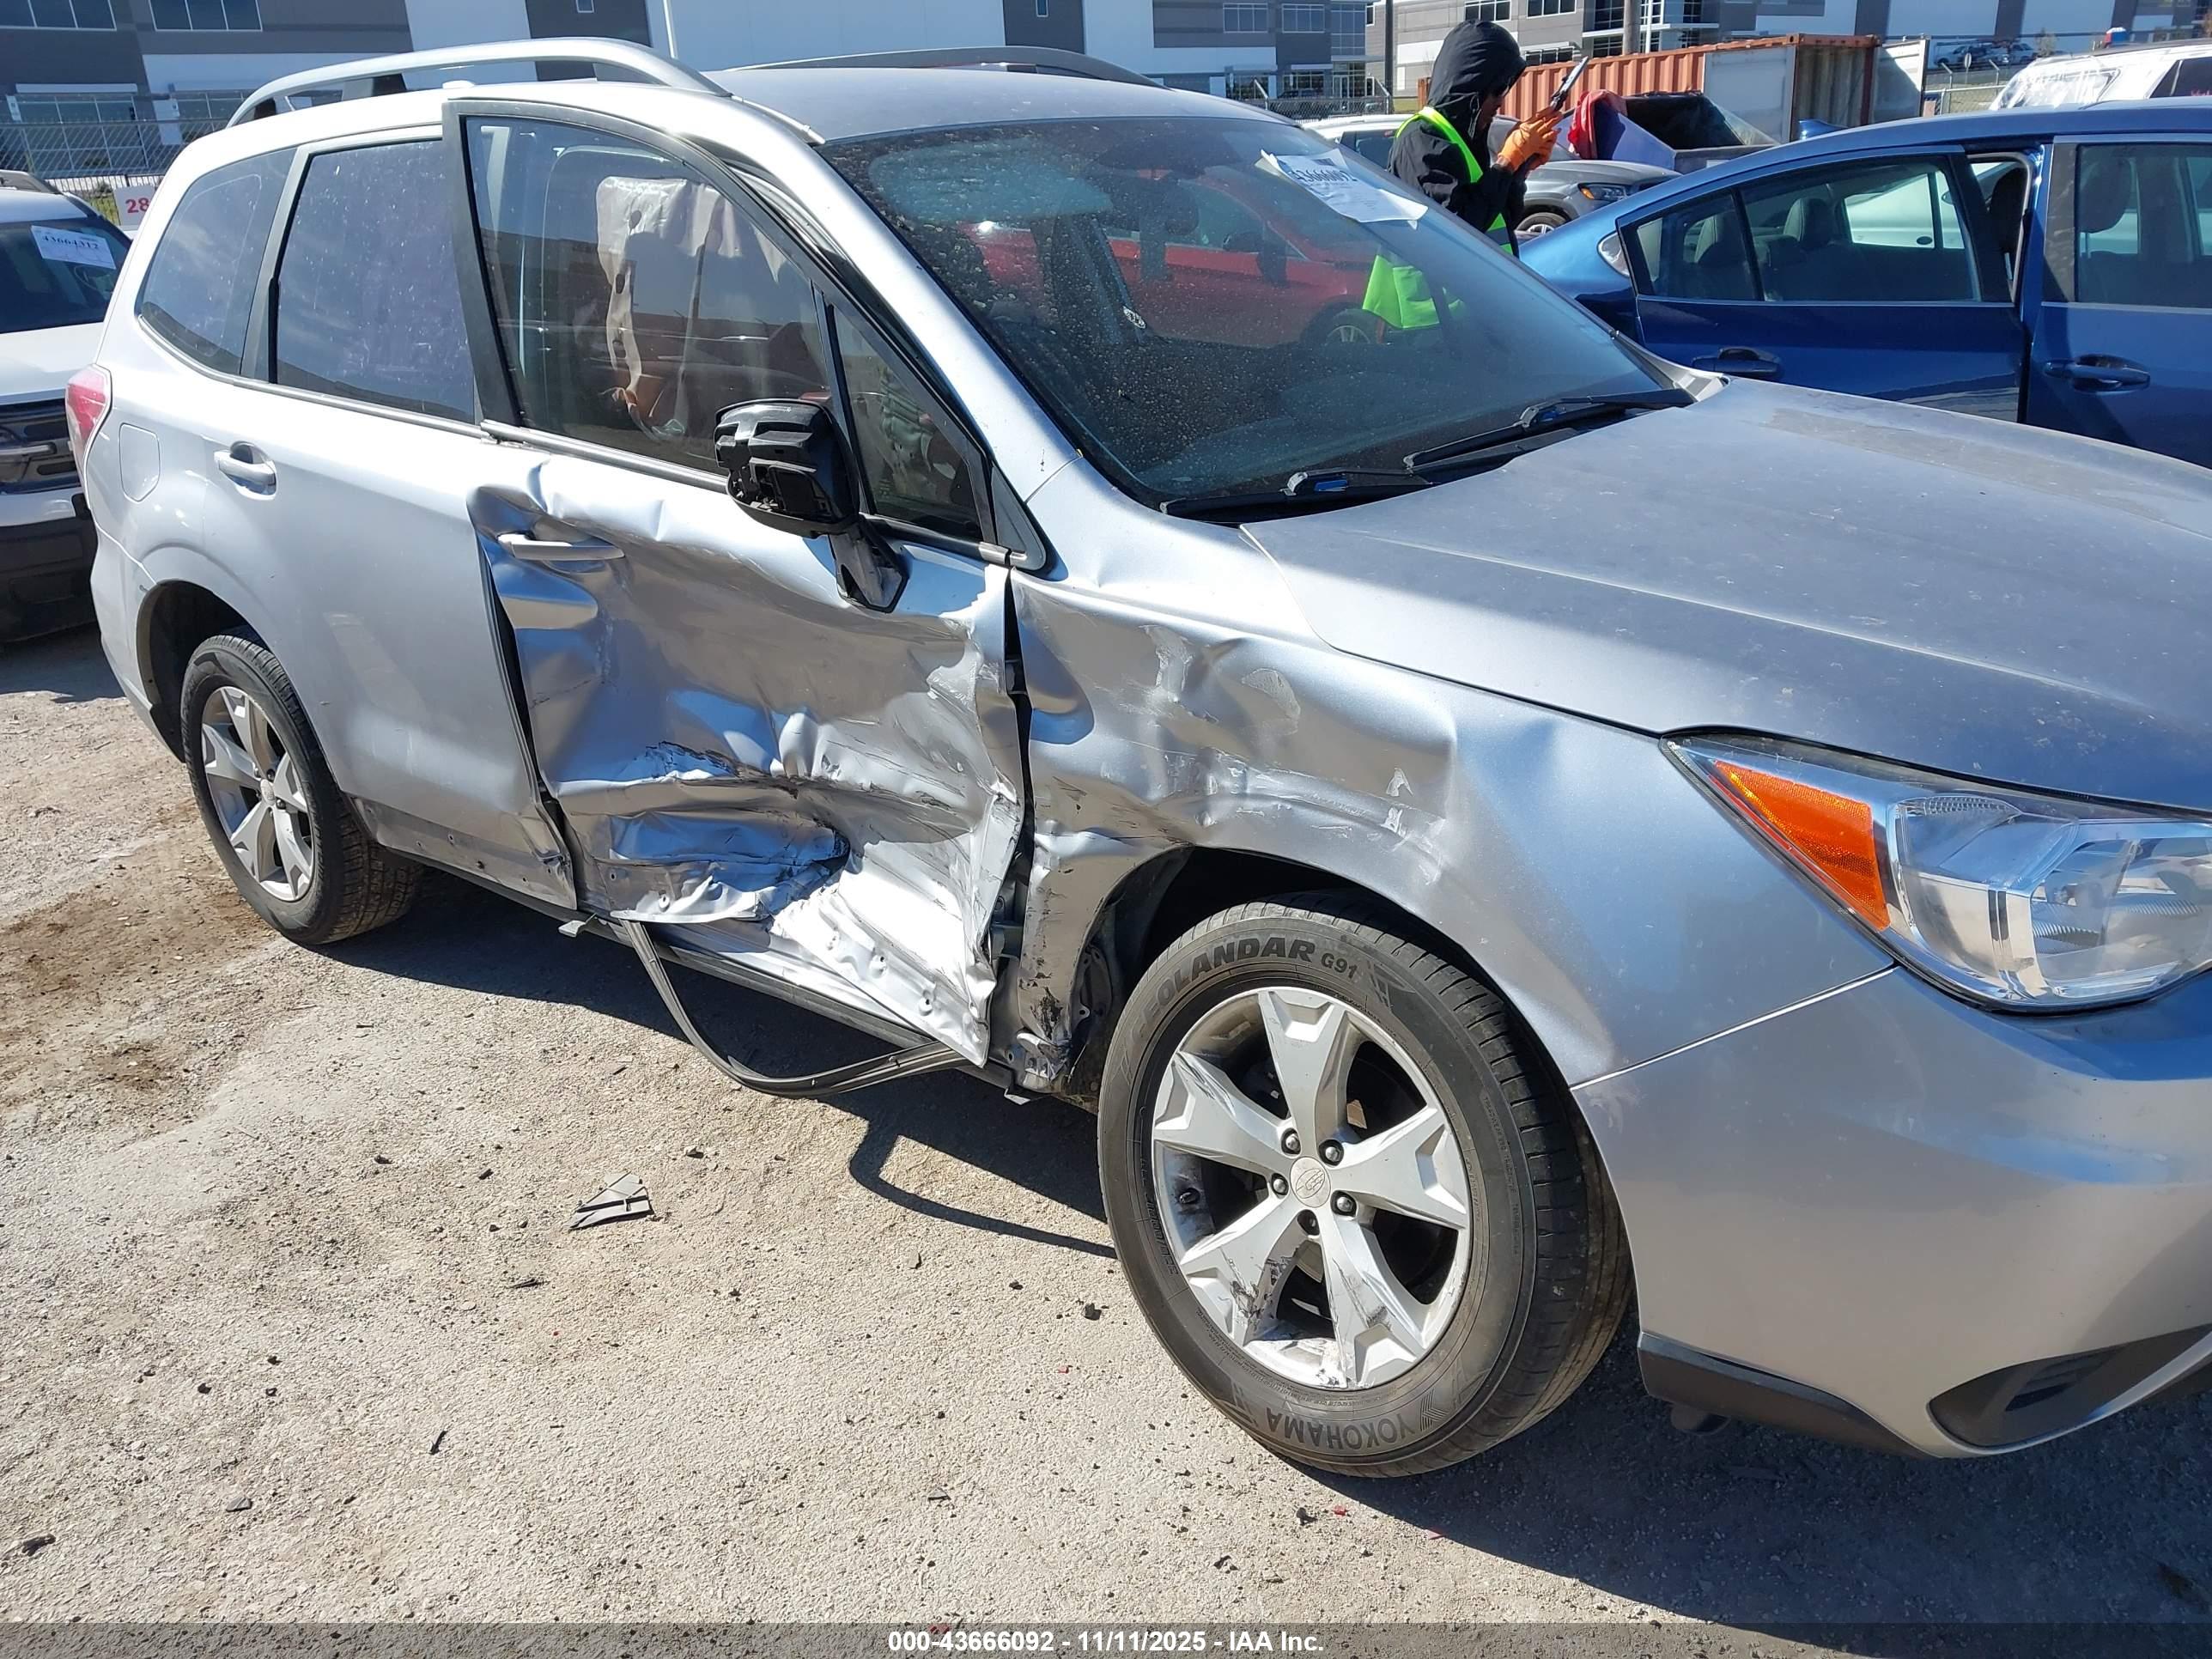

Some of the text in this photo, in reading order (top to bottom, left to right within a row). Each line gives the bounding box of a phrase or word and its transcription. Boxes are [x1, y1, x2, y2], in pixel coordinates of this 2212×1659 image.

[125, 198, 149, 213] 28
[1320, 952, 1357, 979] G91
[1265, 1406, 1416, 1450] YOKOHAMA
